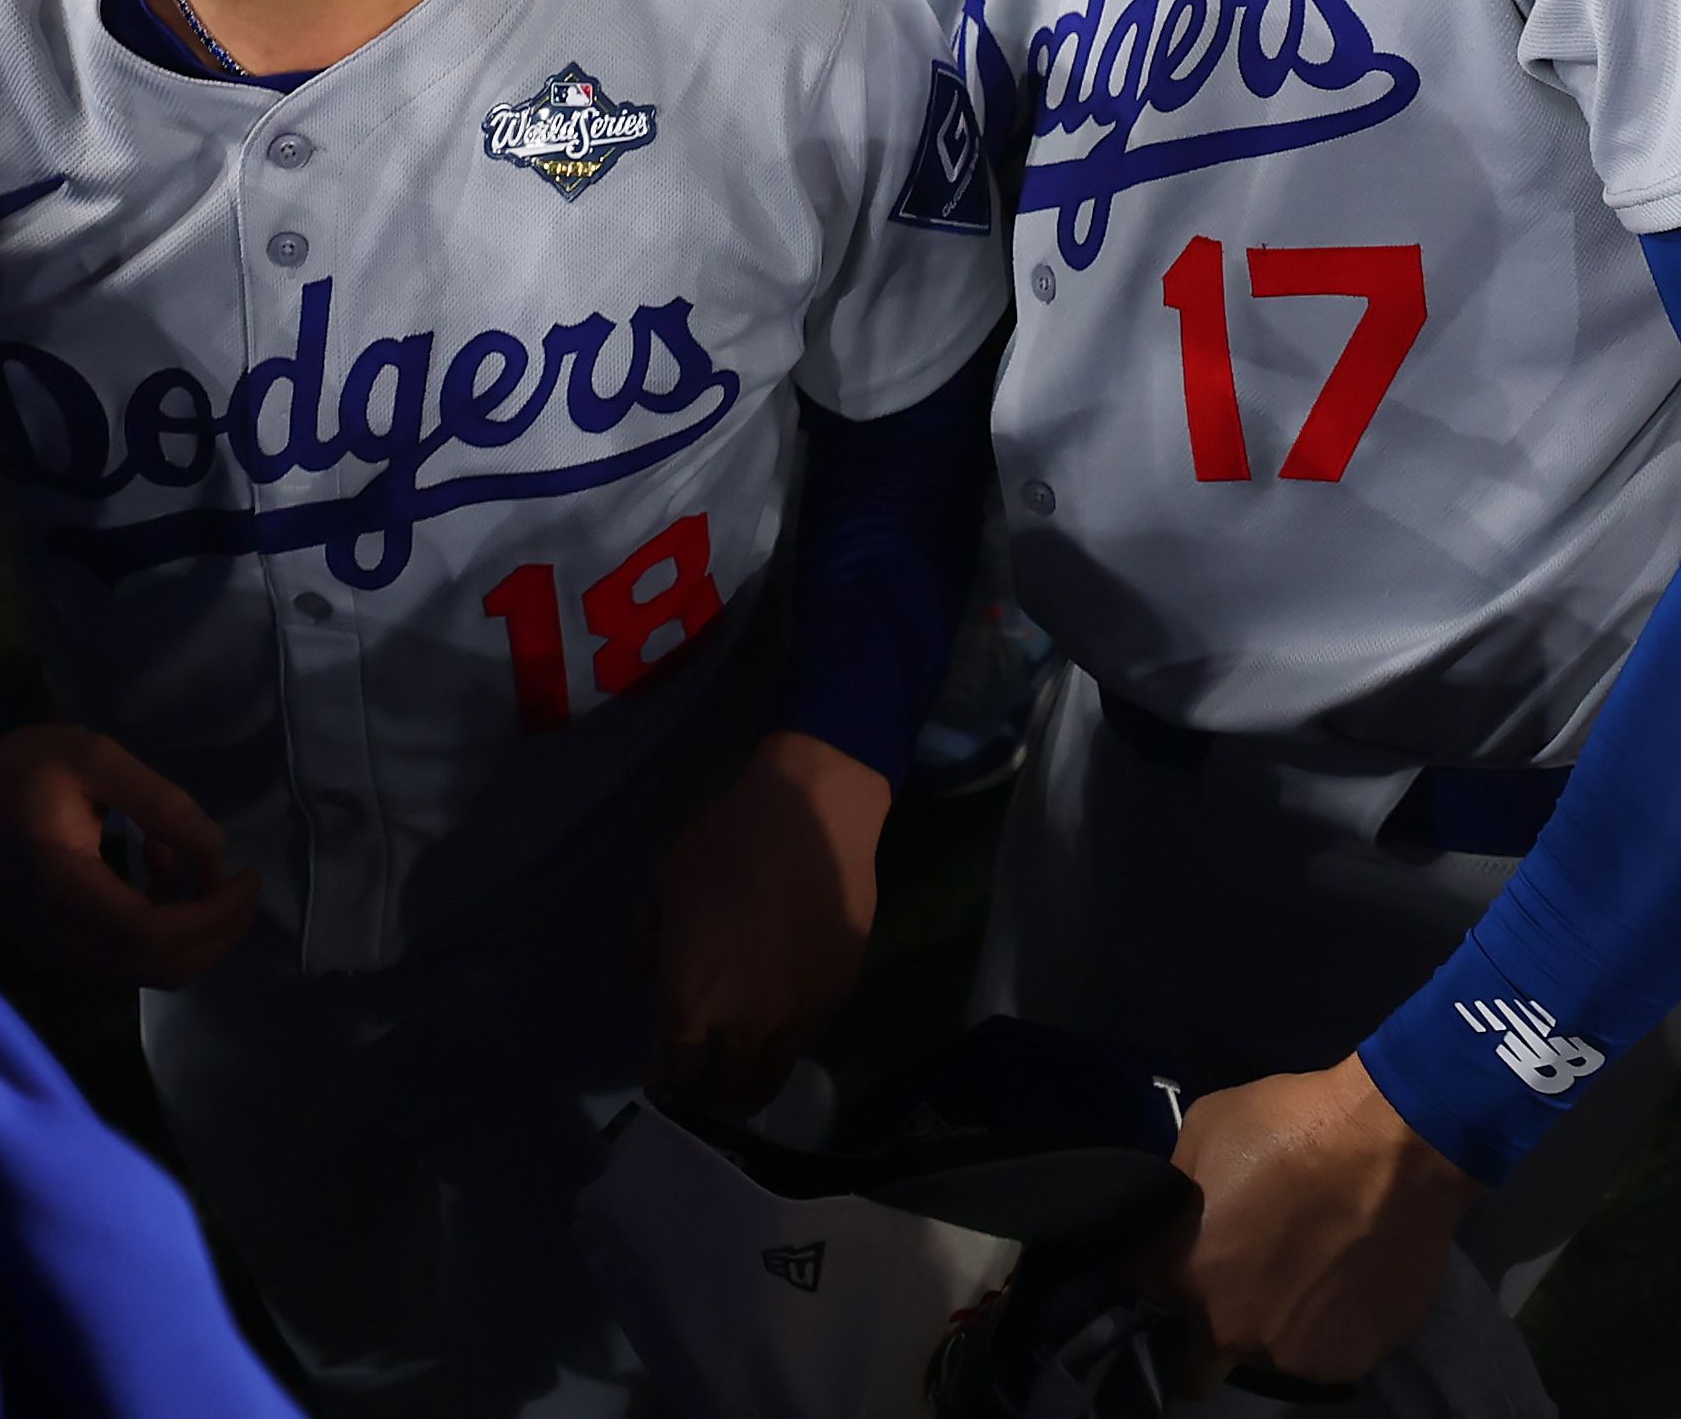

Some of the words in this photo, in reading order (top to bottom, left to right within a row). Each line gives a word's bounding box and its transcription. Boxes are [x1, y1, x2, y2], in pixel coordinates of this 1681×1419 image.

[489, 103, 580, 155] World
[566, 106, 649, 160] Series
[1162, 235, 1428, 483] 17
[483, 512, 725, 733] 18
